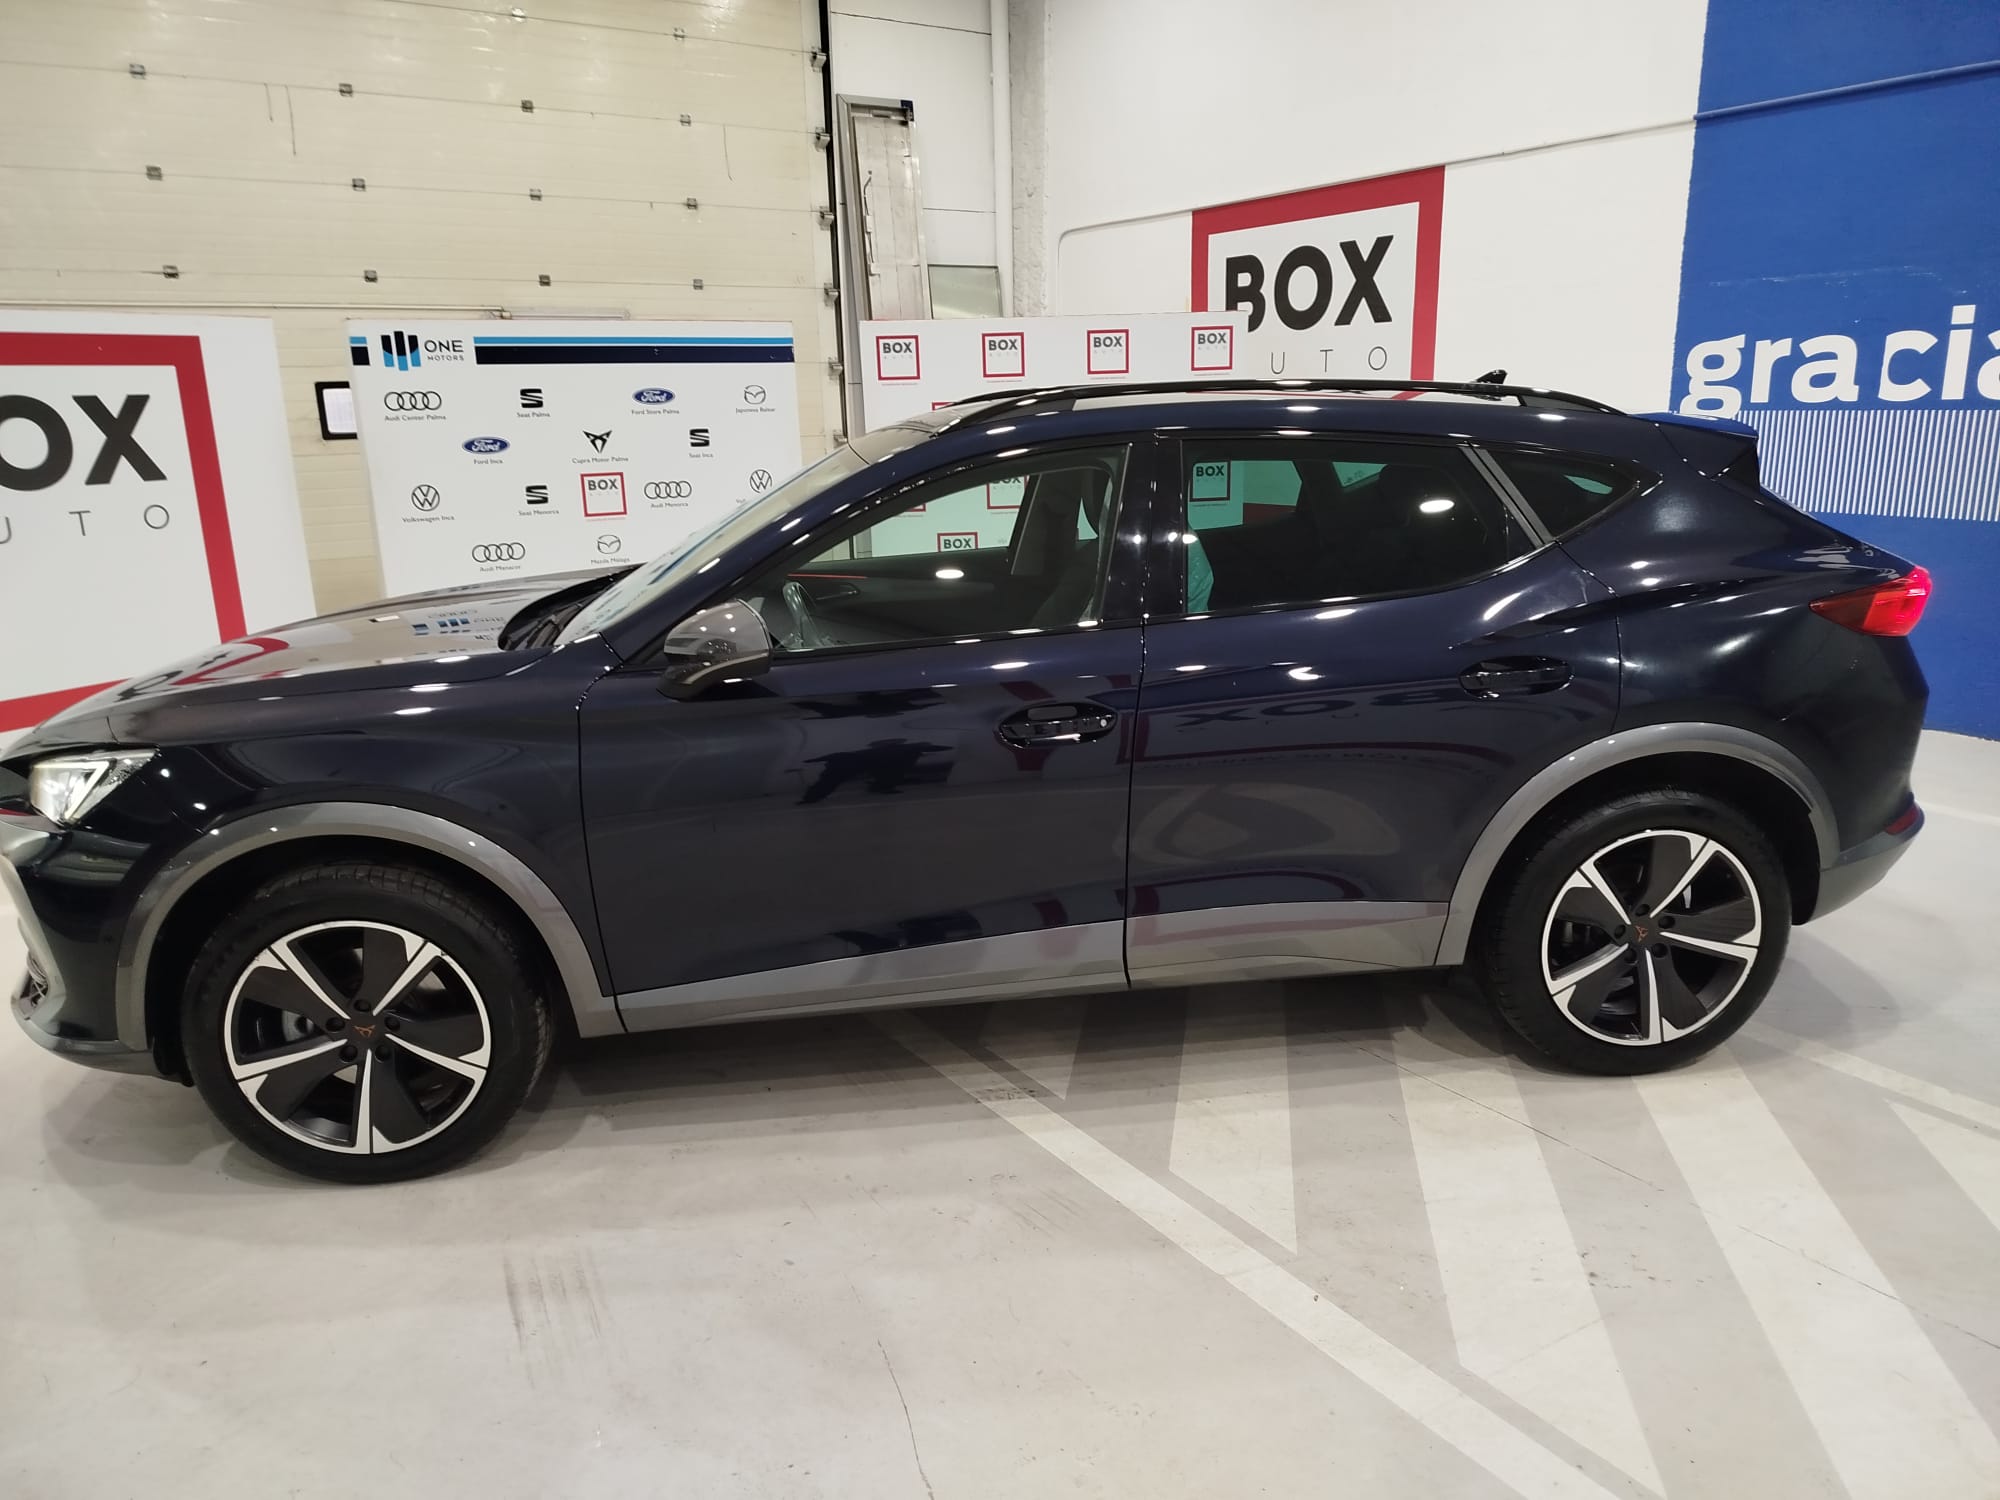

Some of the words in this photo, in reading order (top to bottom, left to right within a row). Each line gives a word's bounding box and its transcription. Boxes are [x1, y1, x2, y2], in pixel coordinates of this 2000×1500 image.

[1225, 234, 1394, 333] BOX
[988, 338, 1018, 351] BOX
[1093, 335, 1123, 348] BOX
[1197, 332, 1227, 345] BOX
[424, 339, 464, 353] ONE
[882, 341, 913, 354] BOX
[426, 354, 465, 362] MOTORS
[640, 390, 667, 402] Ford
[471, 439, 501, 452] Ford
[1195, 465, 1225, 477] BOX
[587, 478, 619, 491] BOX
[943, 537, 973, 550] BOX
